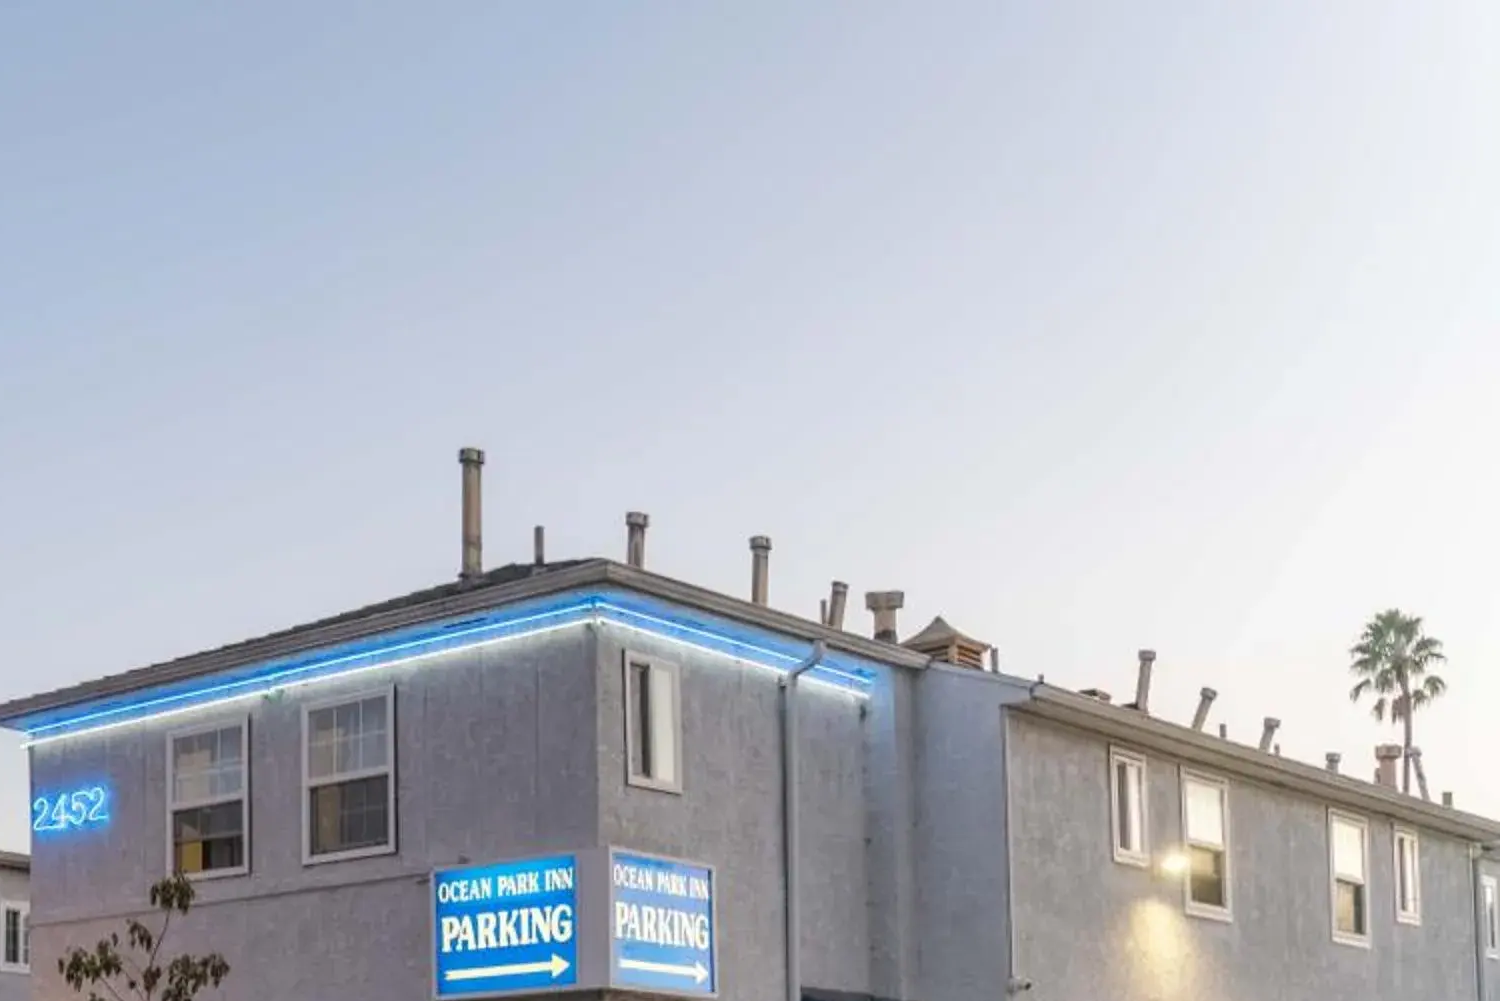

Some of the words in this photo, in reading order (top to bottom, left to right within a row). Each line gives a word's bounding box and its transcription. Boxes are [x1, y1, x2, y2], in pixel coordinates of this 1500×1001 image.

[33, 786, 109, 831] 2452
[438, 877, 493, 904] OCEAN
[497, 870, 541, 899] PARK
[544, 866, 574, 891] INN
[613, 863, 654, 891] OCEAN
[656, 871, 688, 897] PARK
[689, 877, 709, 901] INN
[441, 903, 574, 953] PARKING
[614, 901, 710, 951] PARKING
